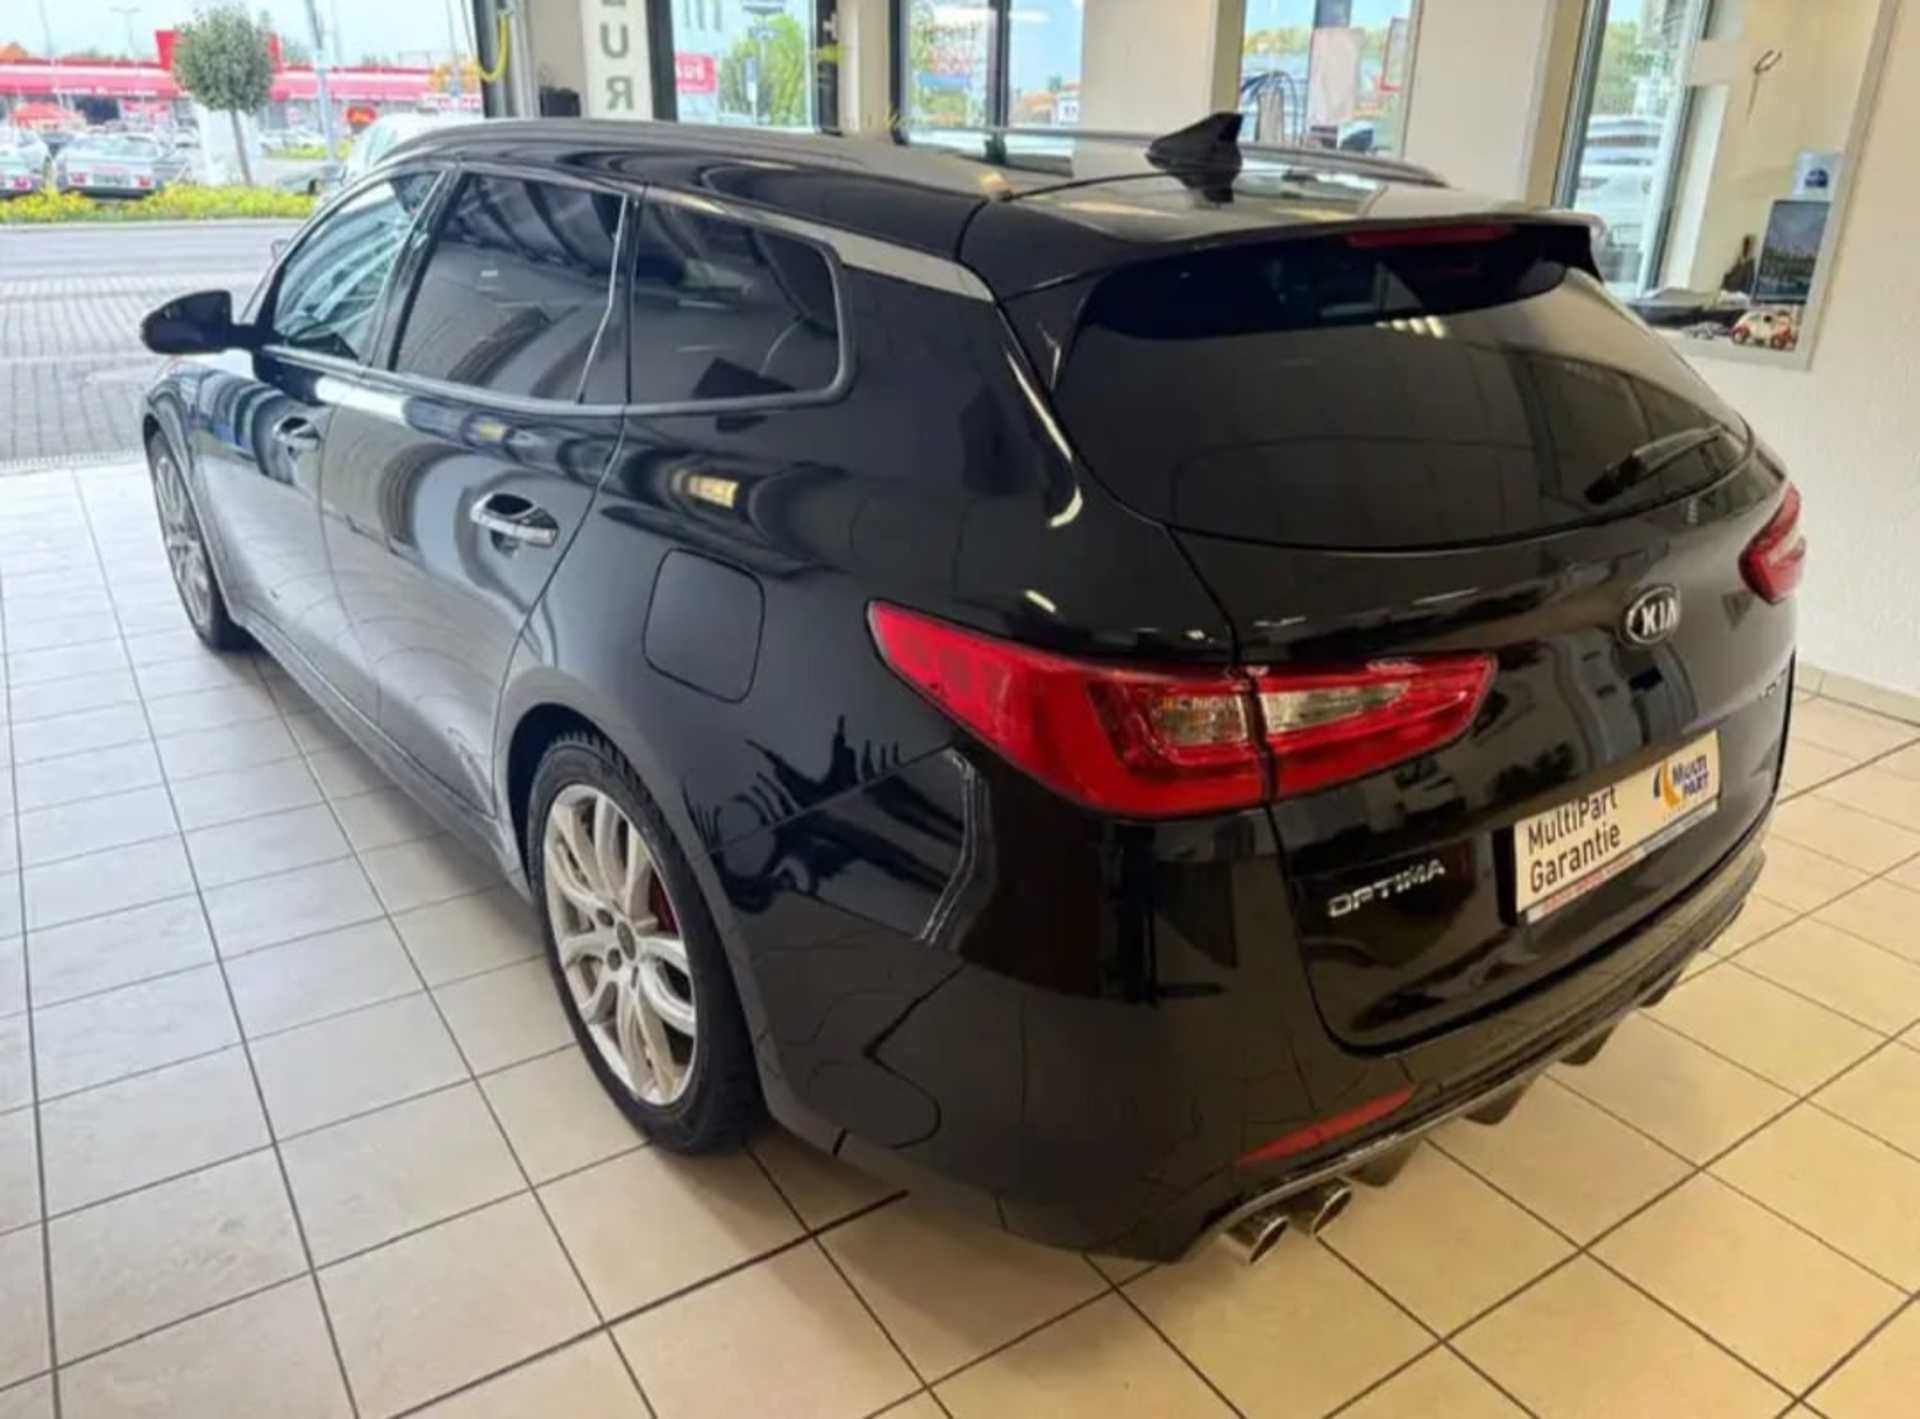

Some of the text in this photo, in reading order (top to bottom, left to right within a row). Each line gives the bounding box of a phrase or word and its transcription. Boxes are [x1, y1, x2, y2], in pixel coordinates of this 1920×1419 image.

[1641, 597, 1678, 636] KIA
[1528, 784, 1617, 855] MultiPart
[1328, 858, 1446, 917] OPTIMA
[1530, 820, 1621, 894] Garantie
